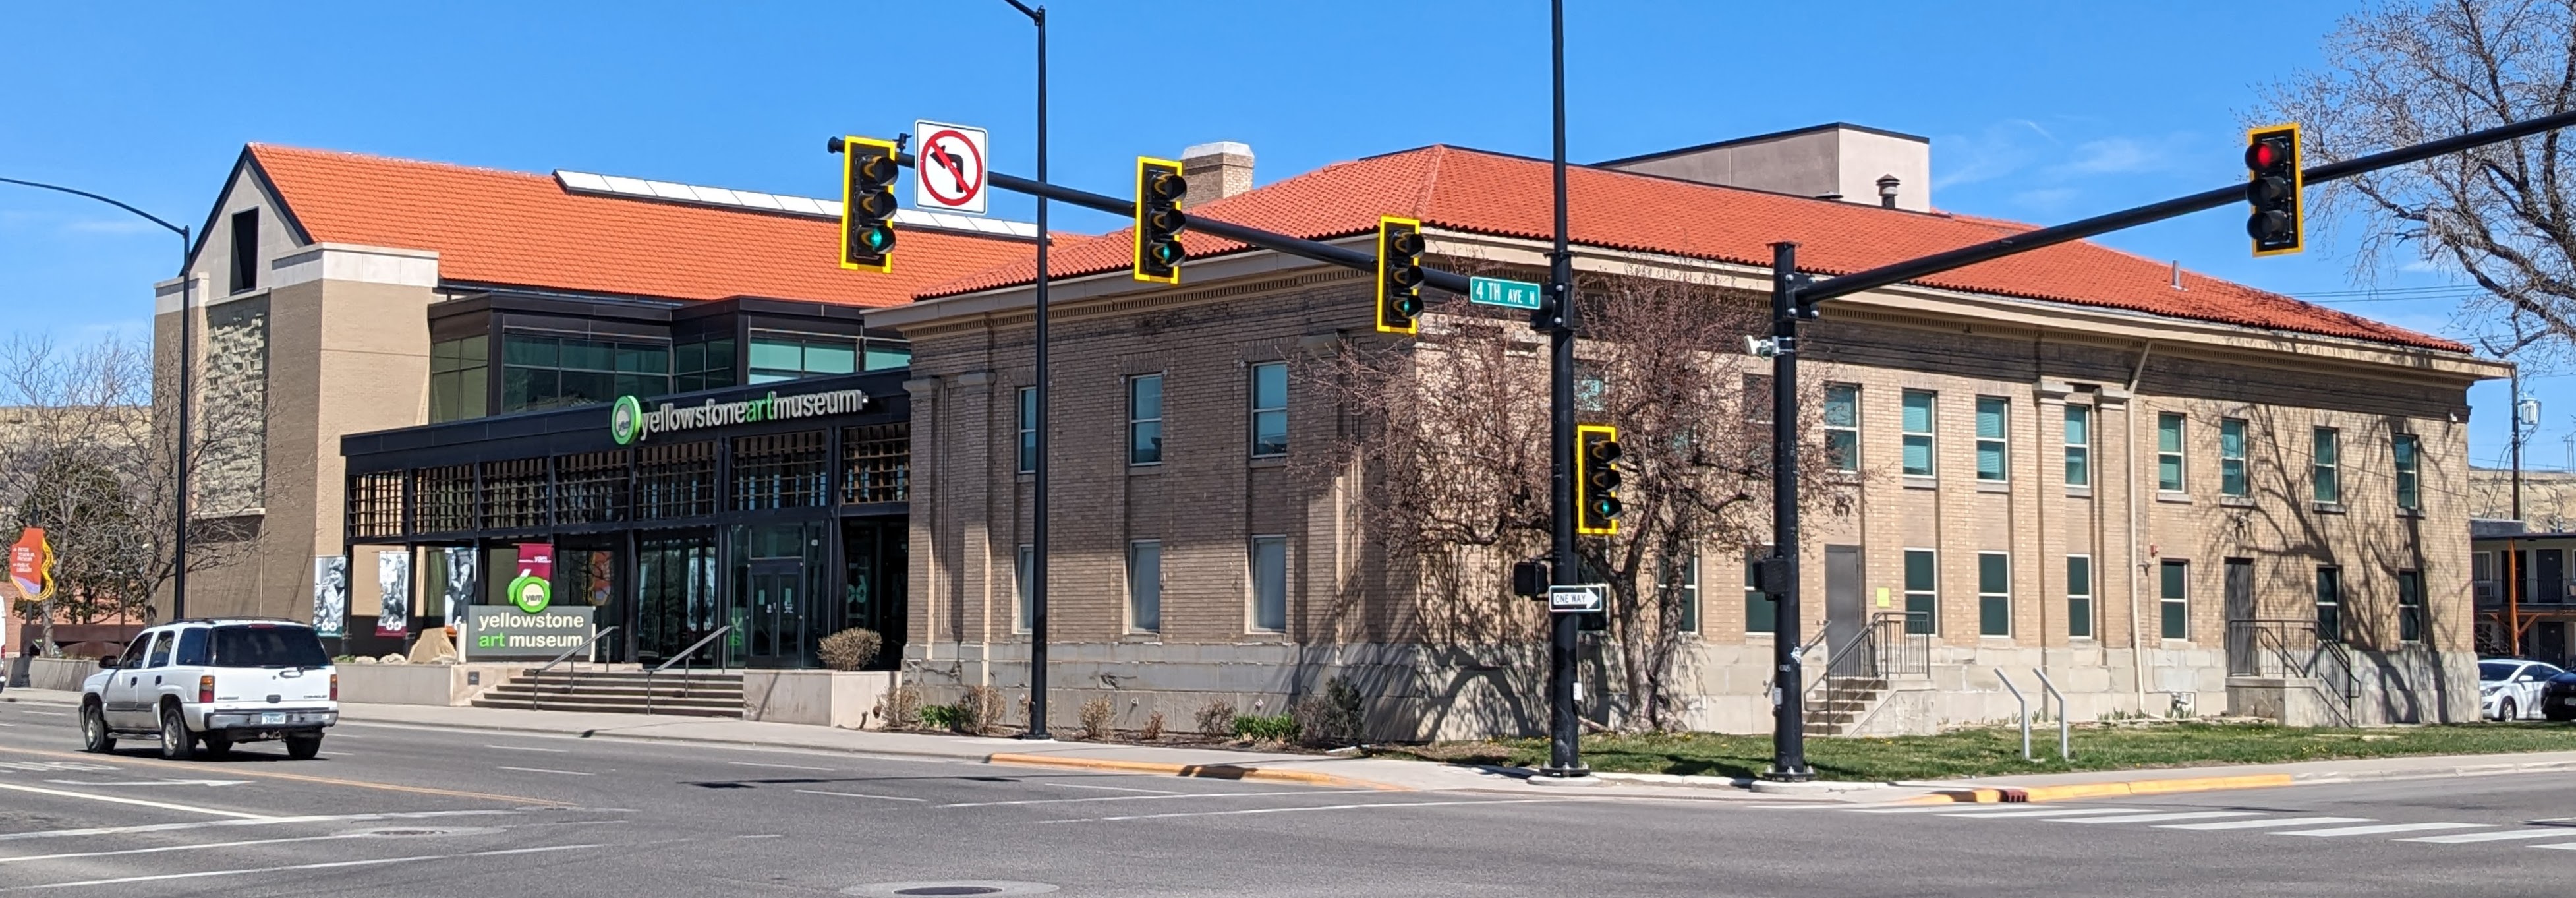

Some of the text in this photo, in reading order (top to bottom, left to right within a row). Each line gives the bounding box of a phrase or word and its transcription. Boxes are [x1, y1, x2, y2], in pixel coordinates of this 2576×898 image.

[1476, 282, 1535, 305] 4 TH AVE N
[526, 593, 543, 605] yam
[1555, 594, 1586, 603] ONE WAY
[321, 617, 337, 631] 60
[386, 616, 402, 631] 60
[478, 612, 584, 631] yellowstone
[479, 632, 583, 647] art museum
